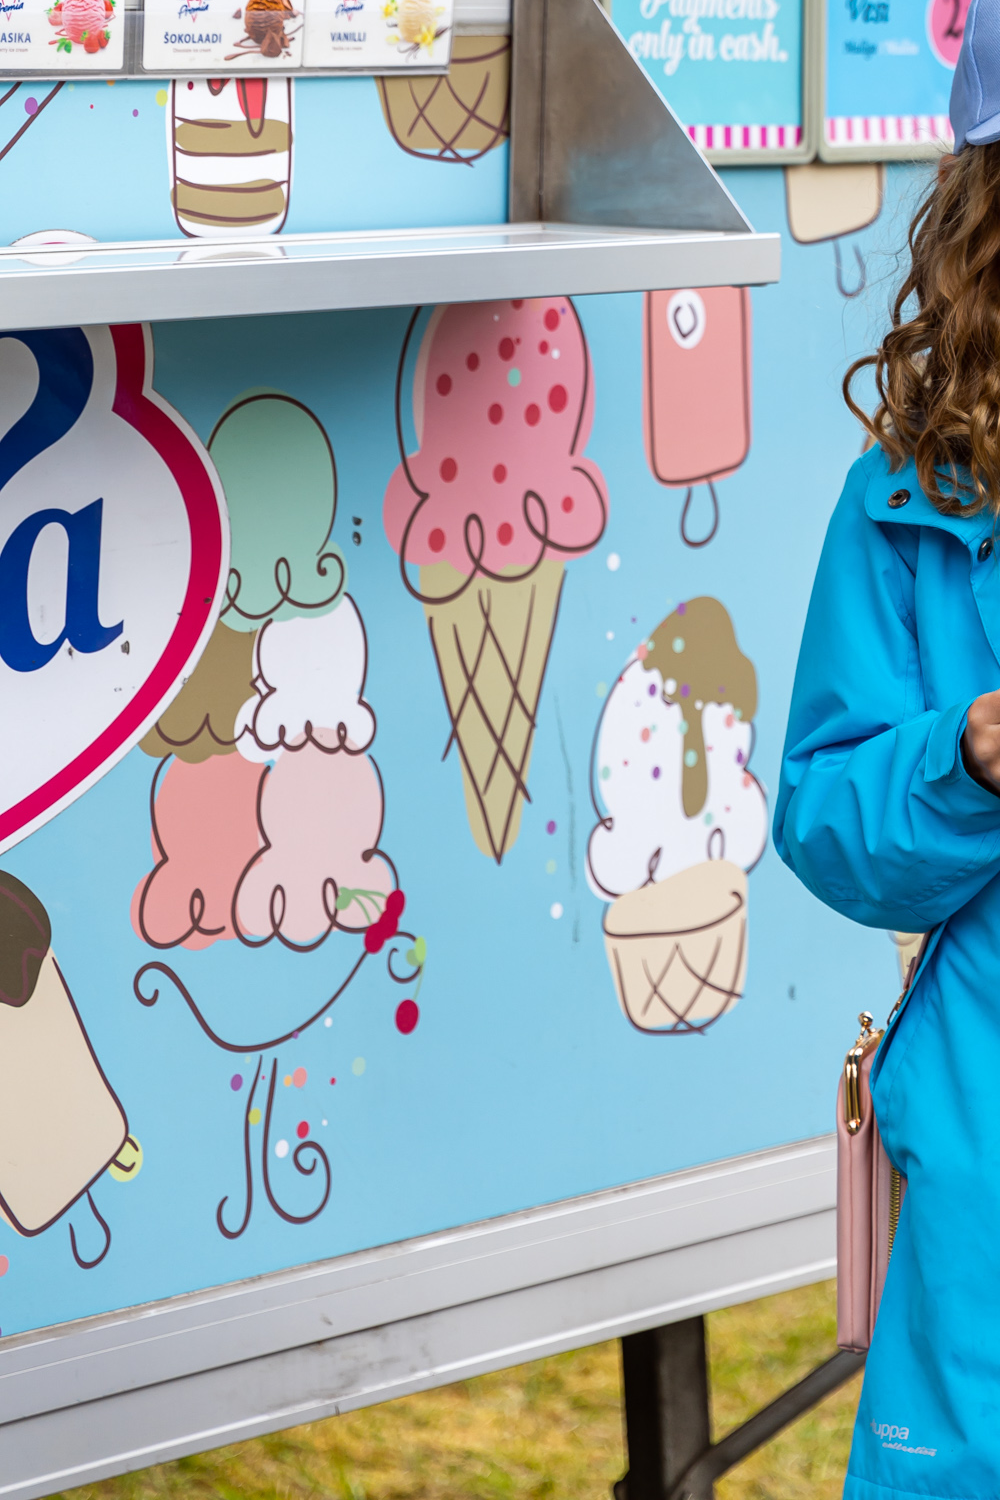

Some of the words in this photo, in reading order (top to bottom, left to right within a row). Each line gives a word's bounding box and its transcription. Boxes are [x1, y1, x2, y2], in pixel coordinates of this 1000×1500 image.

[163, 31, 223, 45] ŠOKOLAADI
[330, 31, 367, 42] VANILLI
[627, 18, 685, 77] only
[688, 24, 717, 61] in
[719, 20, 790, 63] cash.
